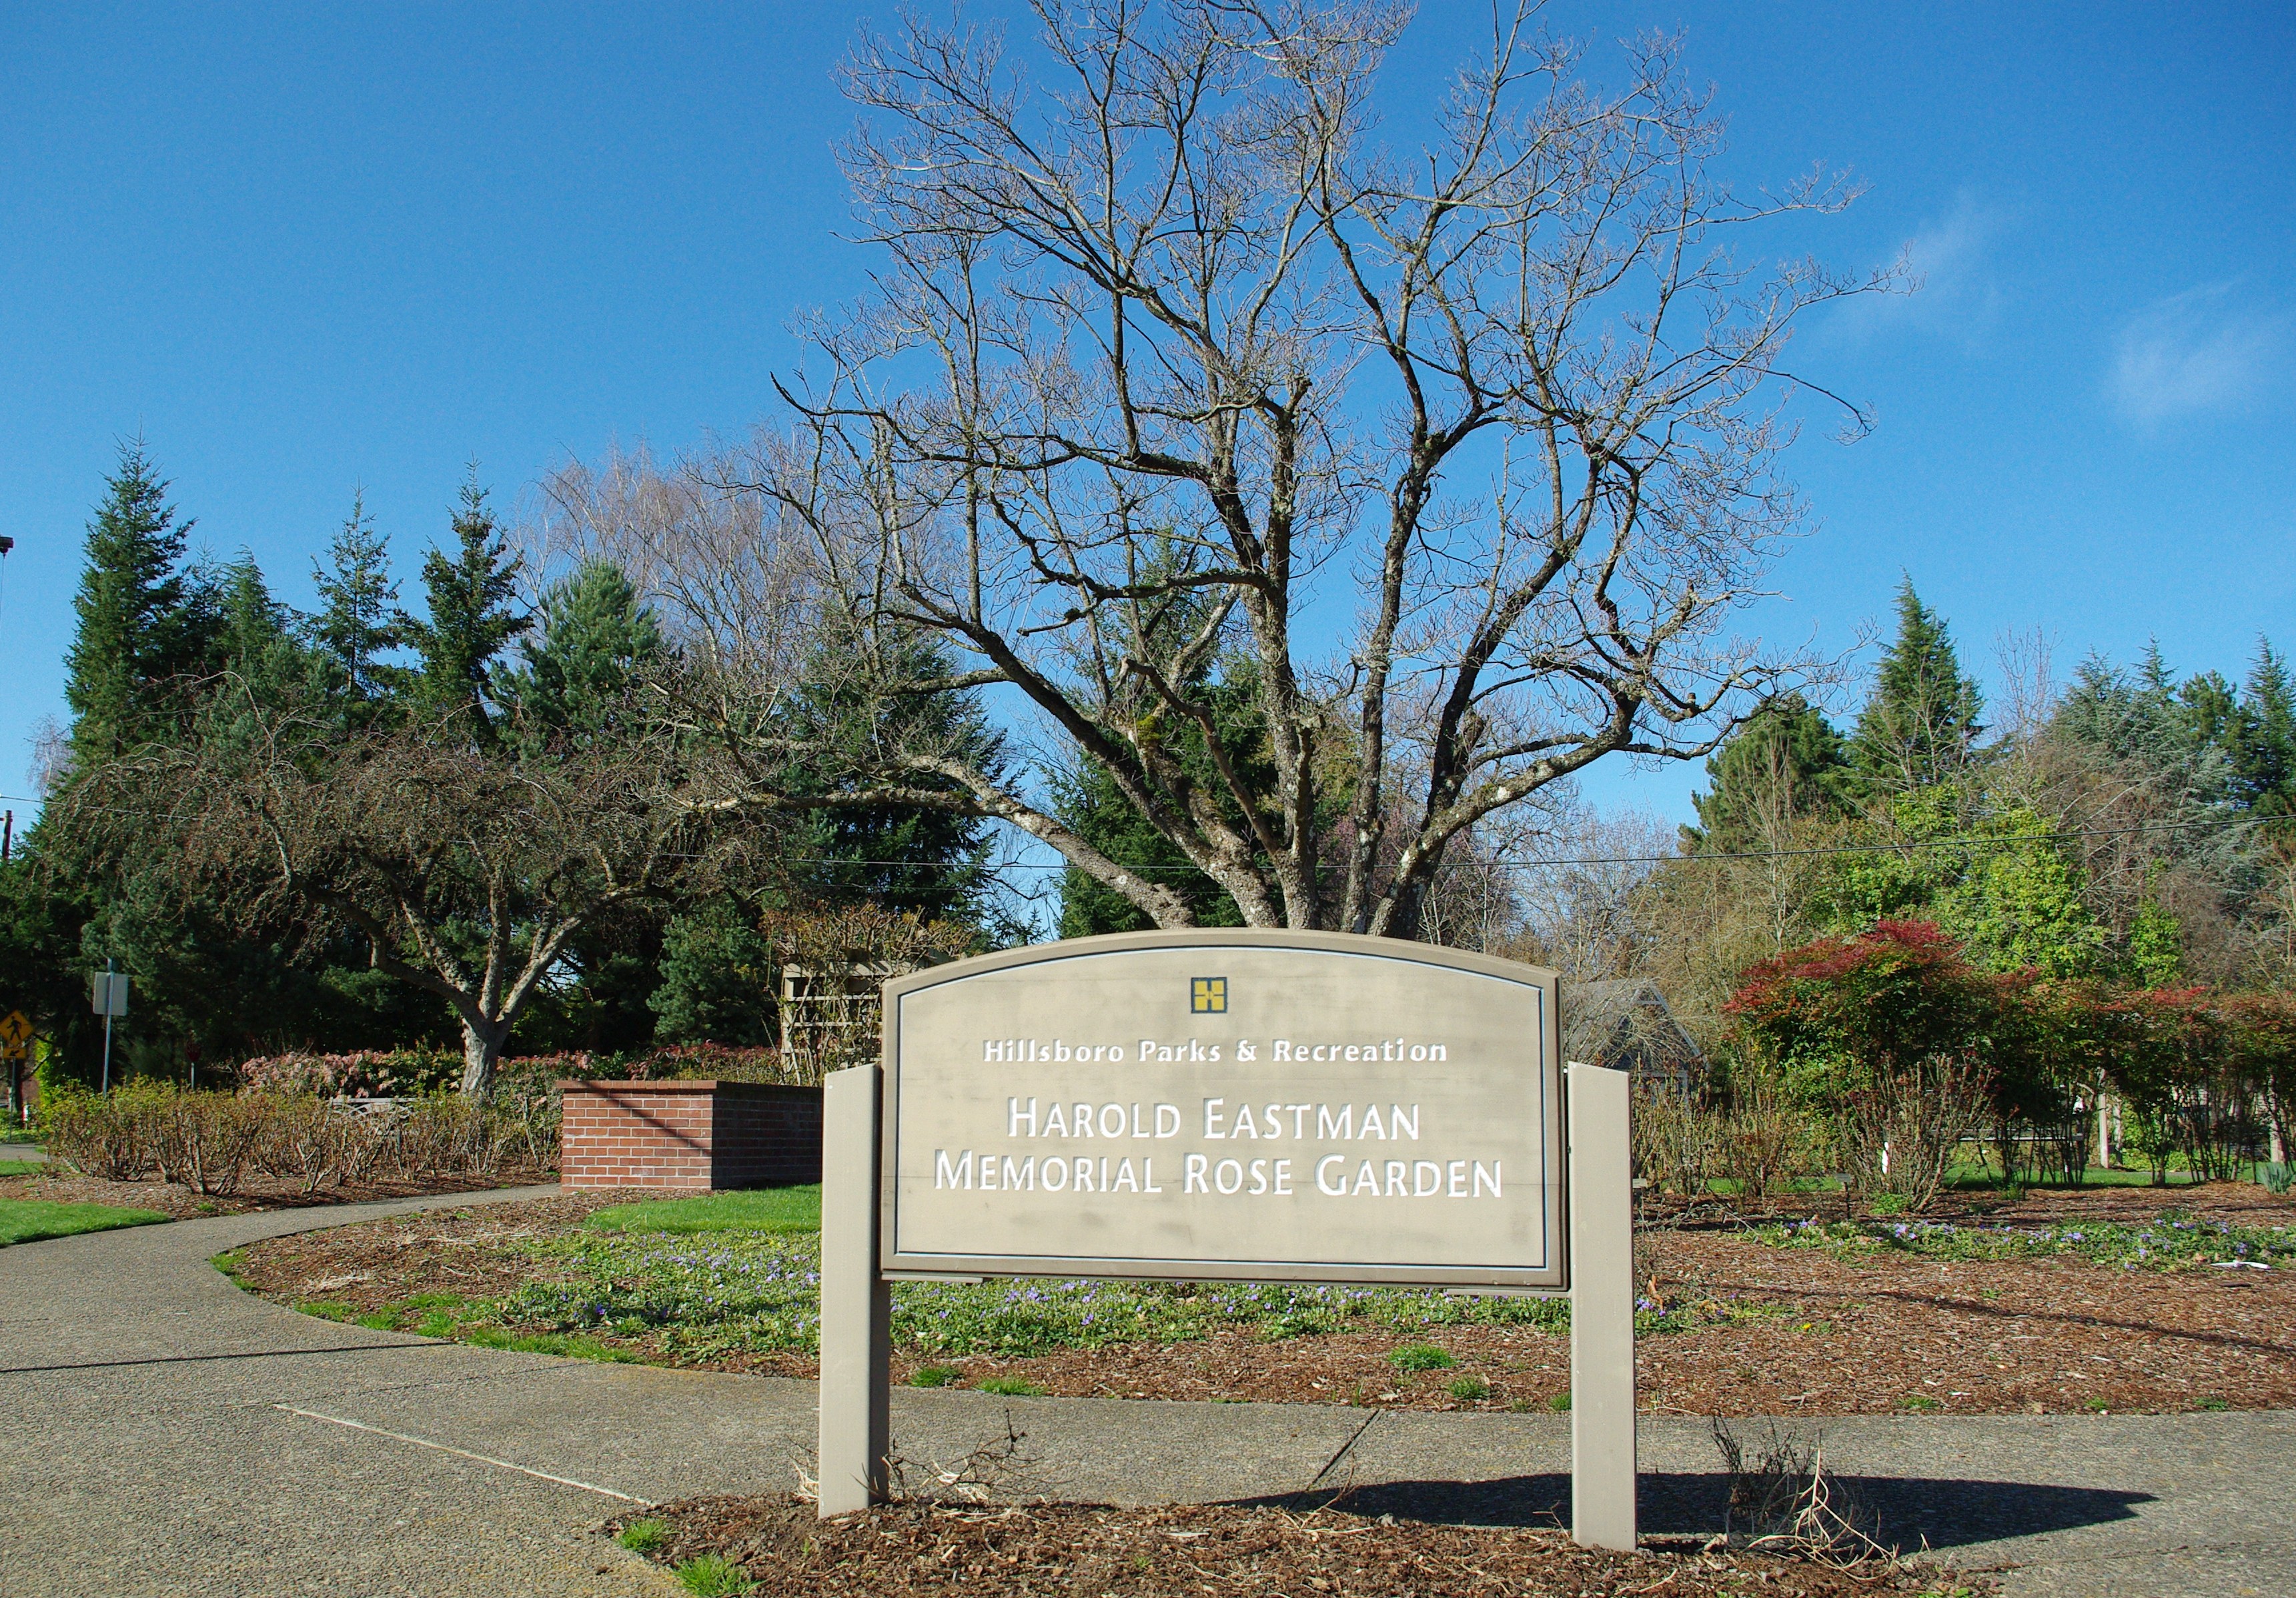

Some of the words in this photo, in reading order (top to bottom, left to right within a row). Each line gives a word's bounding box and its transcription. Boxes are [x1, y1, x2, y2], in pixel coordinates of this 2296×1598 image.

[983, 1038, 1125, 1062] Hillsboro
[1138, 1038, 1221, 1062] Parks
[1235, 1038, 1257, 1062] &
[1272, 1037, 1448, 1062] Recreation
[1007, 1096, 1181, 1138] HAROLD
[1203, 1097, 1420, 1140] EASTMAN
[935, 1148, 1163, 1193] MEMORIAL
[1183, 1152, 1293, 1195] ROSE
[1314, 1152, 1502, 1198] GARDEN
